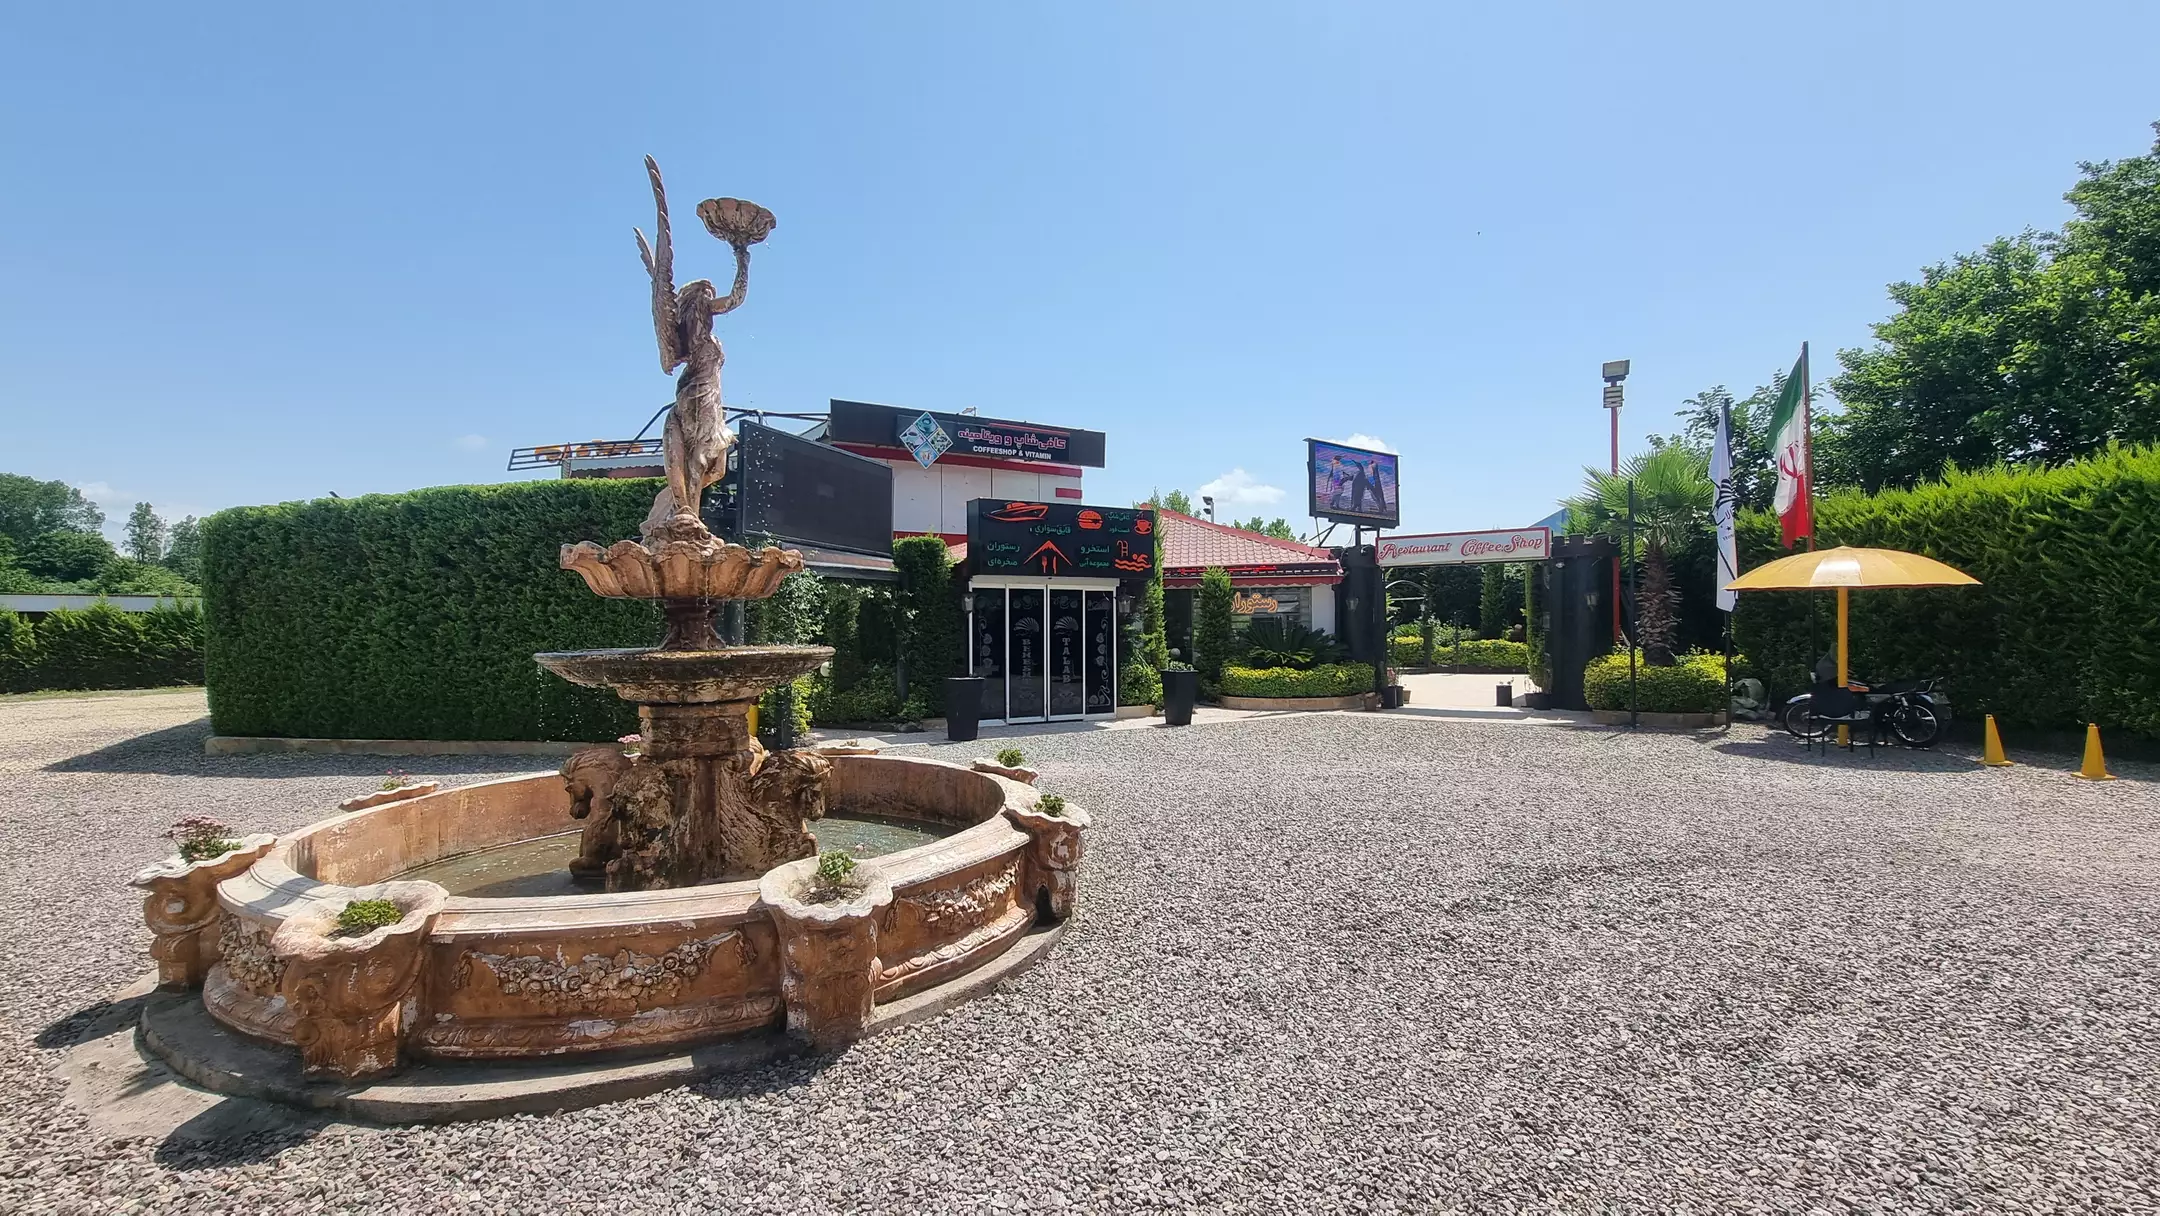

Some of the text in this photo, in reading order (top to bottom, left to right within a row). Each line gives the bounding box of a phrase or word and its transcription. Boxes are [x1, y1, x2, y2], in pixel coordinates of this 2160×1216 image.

[1004, 435, 1013, 446] و
[972, 445, 1017, 456] COFFEESHOP
[1025, 451, 1052, 460] VITAMIN
[986, 541, 1021, 553] رستوران
[1377, 542, 1452, 560] Restaurant
[1061, 637, 1072, 684] TALAB
